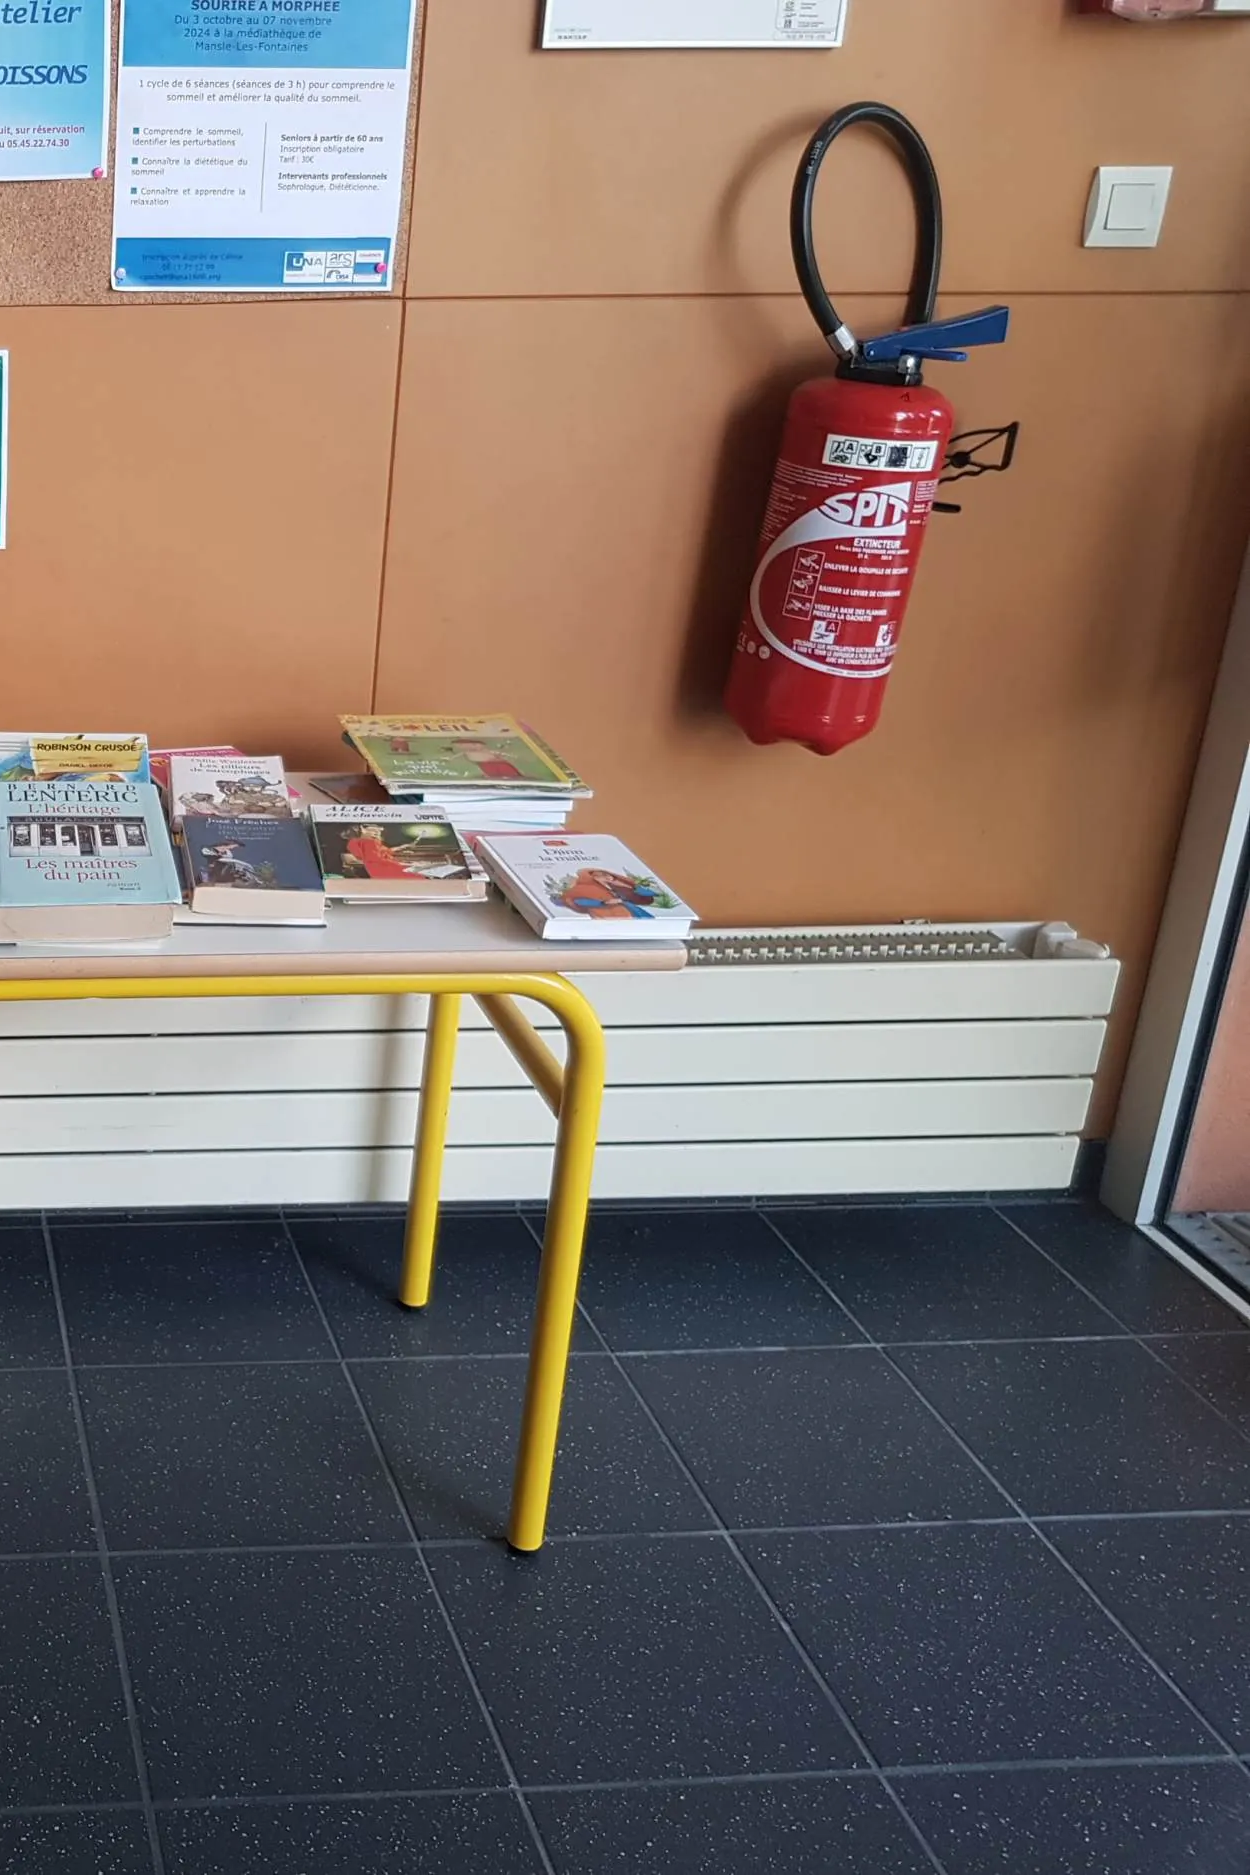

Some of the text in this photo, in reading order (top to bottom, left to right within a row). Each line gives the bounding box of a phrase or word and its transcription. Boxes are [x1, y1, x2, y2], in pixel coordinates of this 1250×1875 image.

[191, 0, 256, 11] SOURIRE
[174, 15, 332, 26] Du 3 octobre au 07 novembre
[184, 28, 322, 40] 2024 à la médiathèque de
[146, 79, 395, 91] cycle de 6 séances (séances de 3 pour comprendre le
[166, 92, 318, 104] sommeil et améliorer la qualité du
[15, 127, 30, 136] sur
[32, 124, 85, 136] réservation
[143, 128, 192, 136] Comprendre
[6, 138, 70, 149] 05.45.22.74.30
[320, 135, 342, 143] partir
[278, 172, 329, 180] Intervenants
[195, 188, 234, 196] apprendre
[846, 443, 854, 451] A
[825, 492, 908, 527] SPIT
[854, 538, 901, 549] EXTINCTEUR
[824, 563, 849, 572] ENLEVER
[843, 587, 868, 597] LE LEVIER
[832, 605, 838, 613] LA
[837, 612, 844, 620] LA
[37, 743, 91, 751] ROBINSON
[8, 790, 138, 803] LENTERIC
[28, 803, 121, 815] L'héritage
[25, 858, 138, 869] Les maîtres
[44, 870, 120, 883] du pain
